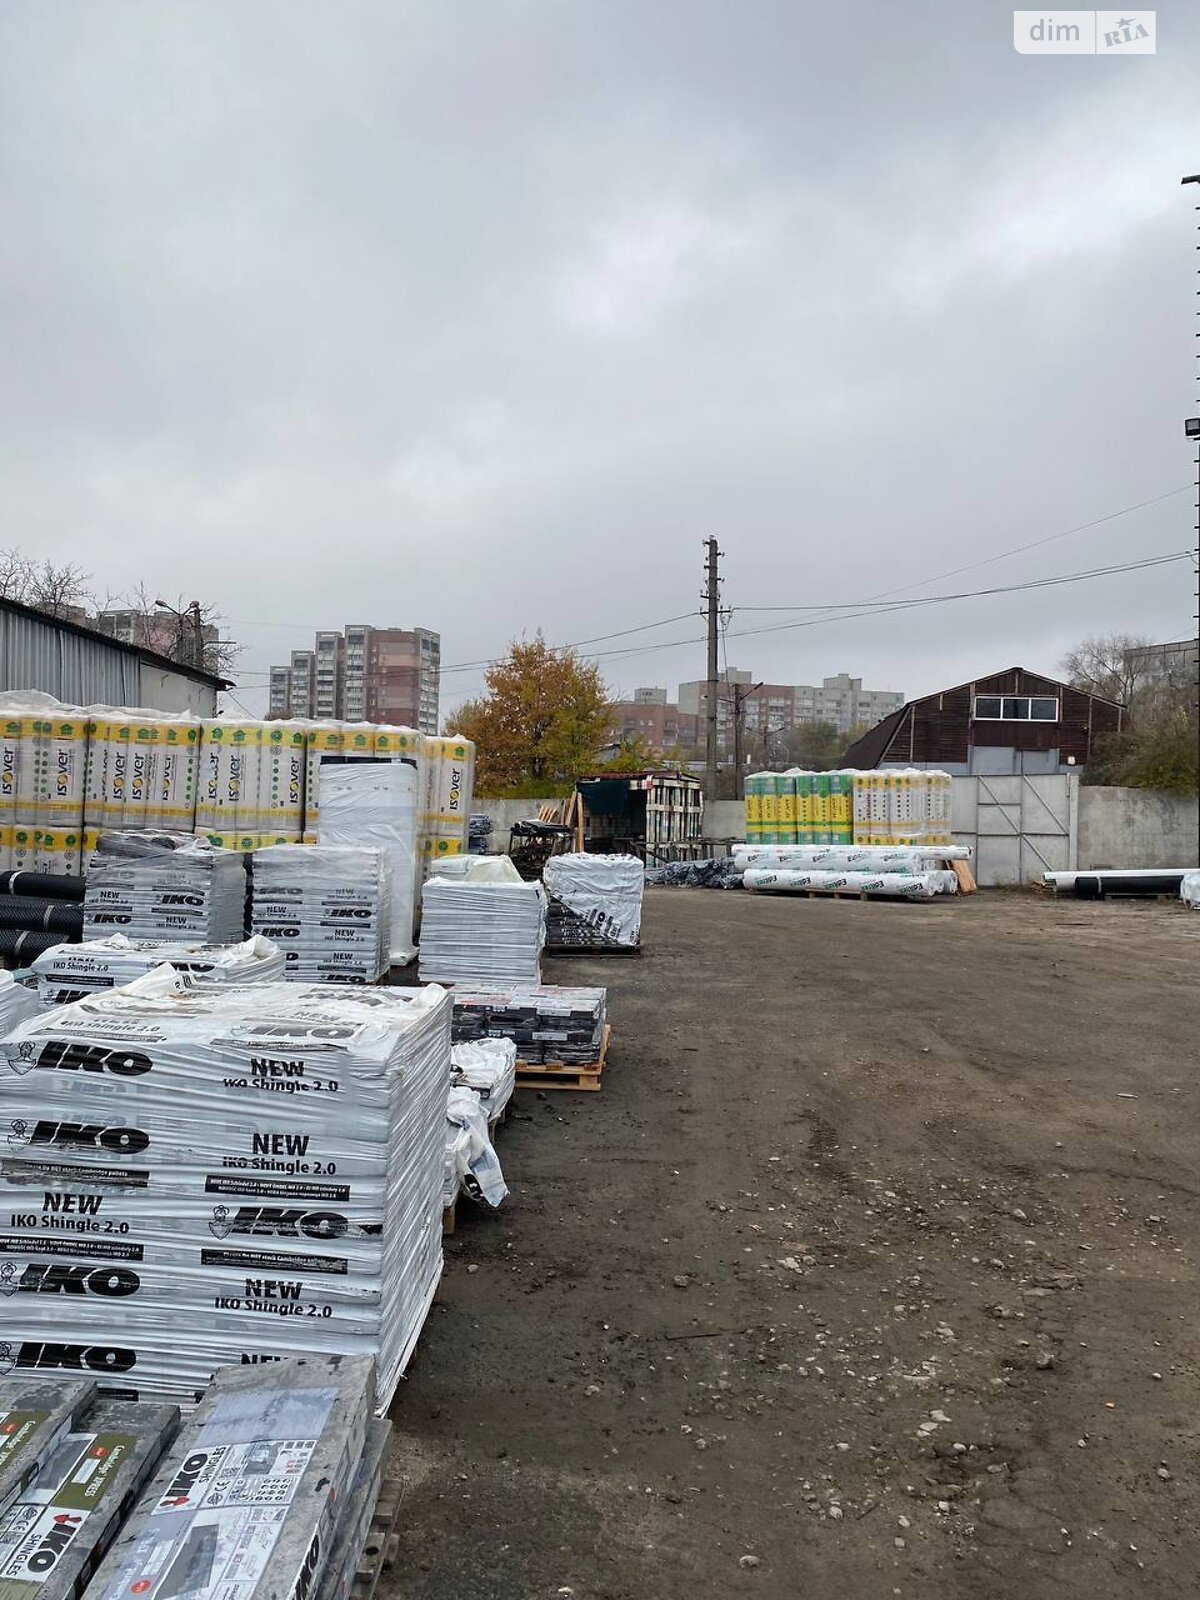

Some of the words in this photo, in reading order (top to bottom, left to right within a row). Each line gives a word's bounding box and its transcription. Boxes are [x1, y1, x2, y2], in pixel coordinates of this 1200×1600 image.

[162, 895, 204, 906] IKO
[94, 914, 132, 924] IKO
[331, 909, 372, 918] IKO
[261, 928, 300, 938] IKO
[67, 962, 96, 972] Shingle
[326, 975, 366, 984] IKO
[37, 1041, 153, 1076] IKO
[251, 1058, 304, 1077] NEW
[252, 1078, 310, 1094] Shingle
[313, 1081, 338, 1092] 2.0
[30, 1120, 150, 1154] IKO
[253, 1133, 310, 1157] NEW
[251, 1157, 309, 1175] Shingle
[313, 1161, 336, 1175] 2.0
[42, 1192, 103, 1215] NEW
[11, 1214, 37, 1227] IKO
[41, 1215, 100, 1233] Shingle
[104, 1220, 130, 1234] 2.0
[230, 1206, 349, 1240] IKO
[18, 1263, 140, 1297] IKO
[244, 1278, 303, 1300] NEW
[215, 1297, 240, 1310] IKO
[244, 1299, 304, 1316] Shingle
[307, 1304, 332, 1318] 2.0
[15, 1341, 137, 1372] IKO
[165, 1453, 208, 1497] IKO
[6, 1533, 42, 1576] SHINGLES
[27, 1522, 77, 1573] IKO
